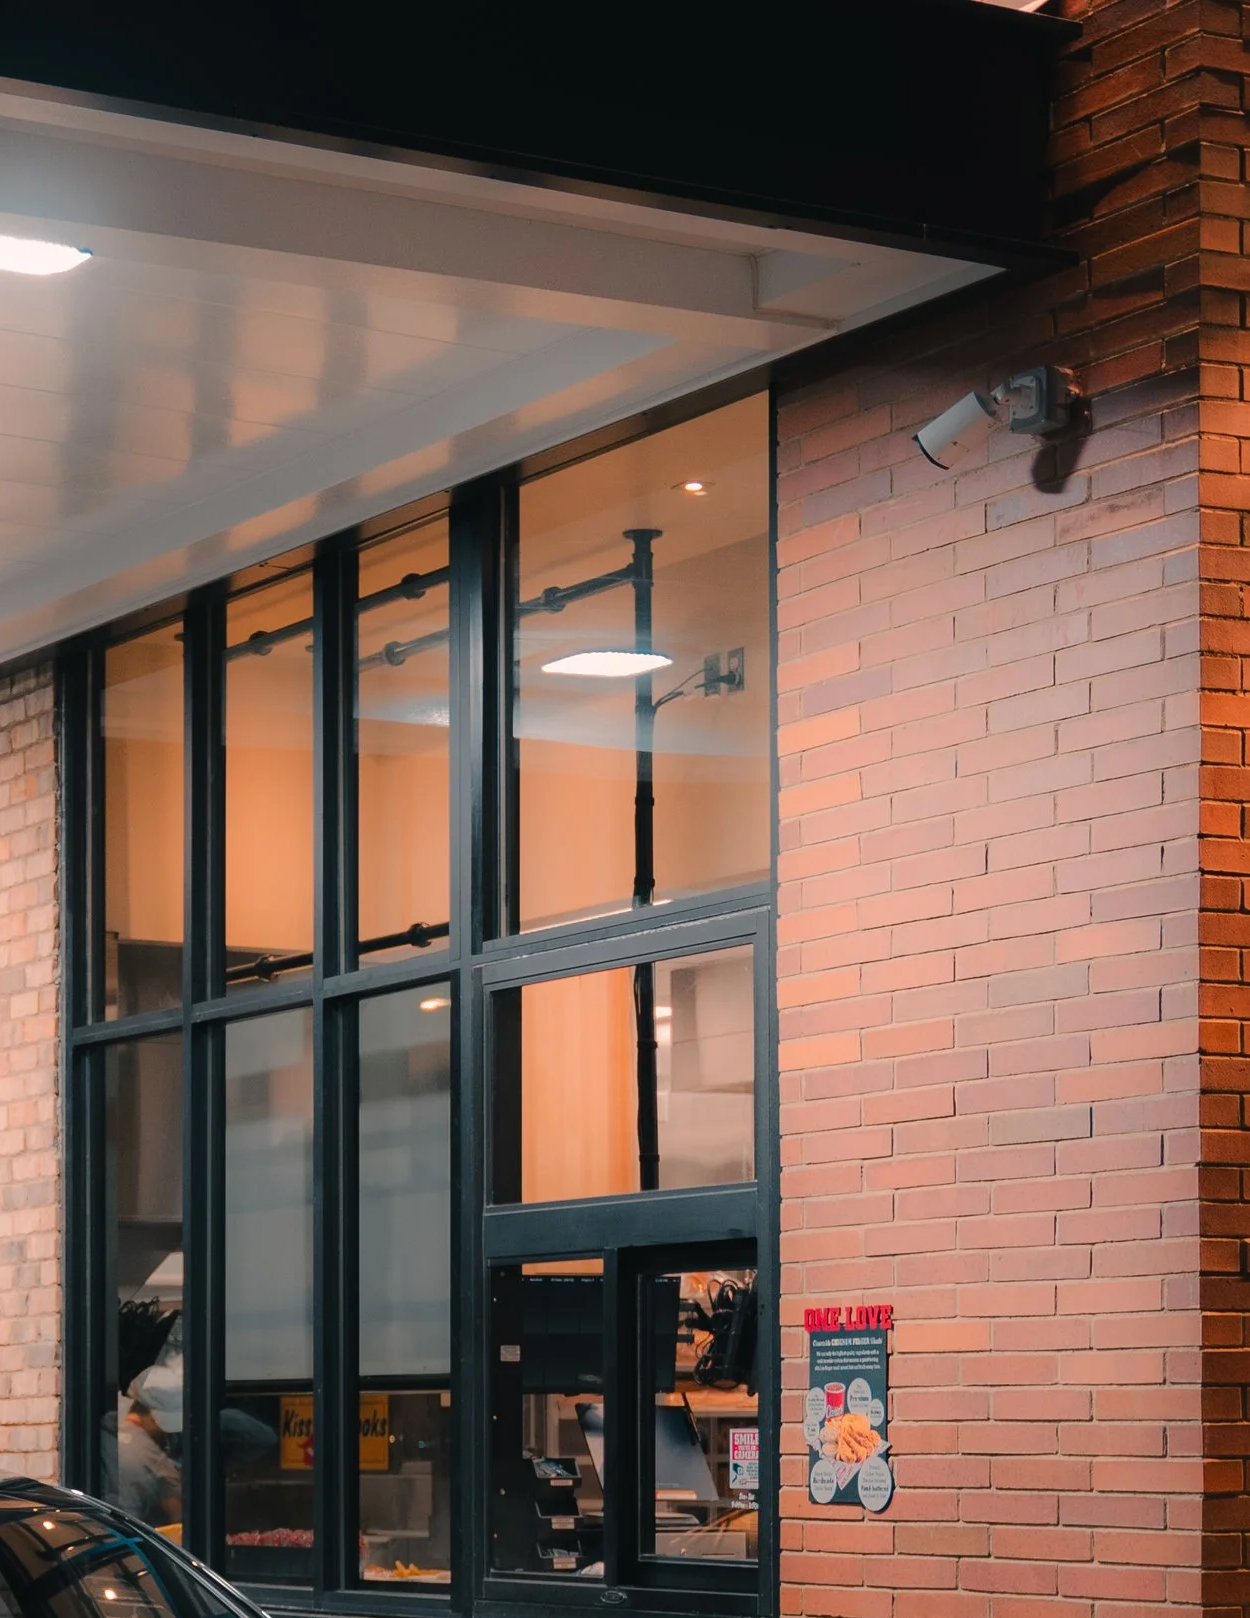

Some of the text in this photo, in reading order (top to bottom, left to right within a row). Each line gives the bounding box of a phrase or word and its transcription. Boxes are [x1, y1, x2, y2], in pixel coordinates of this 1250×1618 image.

[804, 1304, 892, 1333] ONE LOVE
[283, 1409, 313, 1437] Kiss
